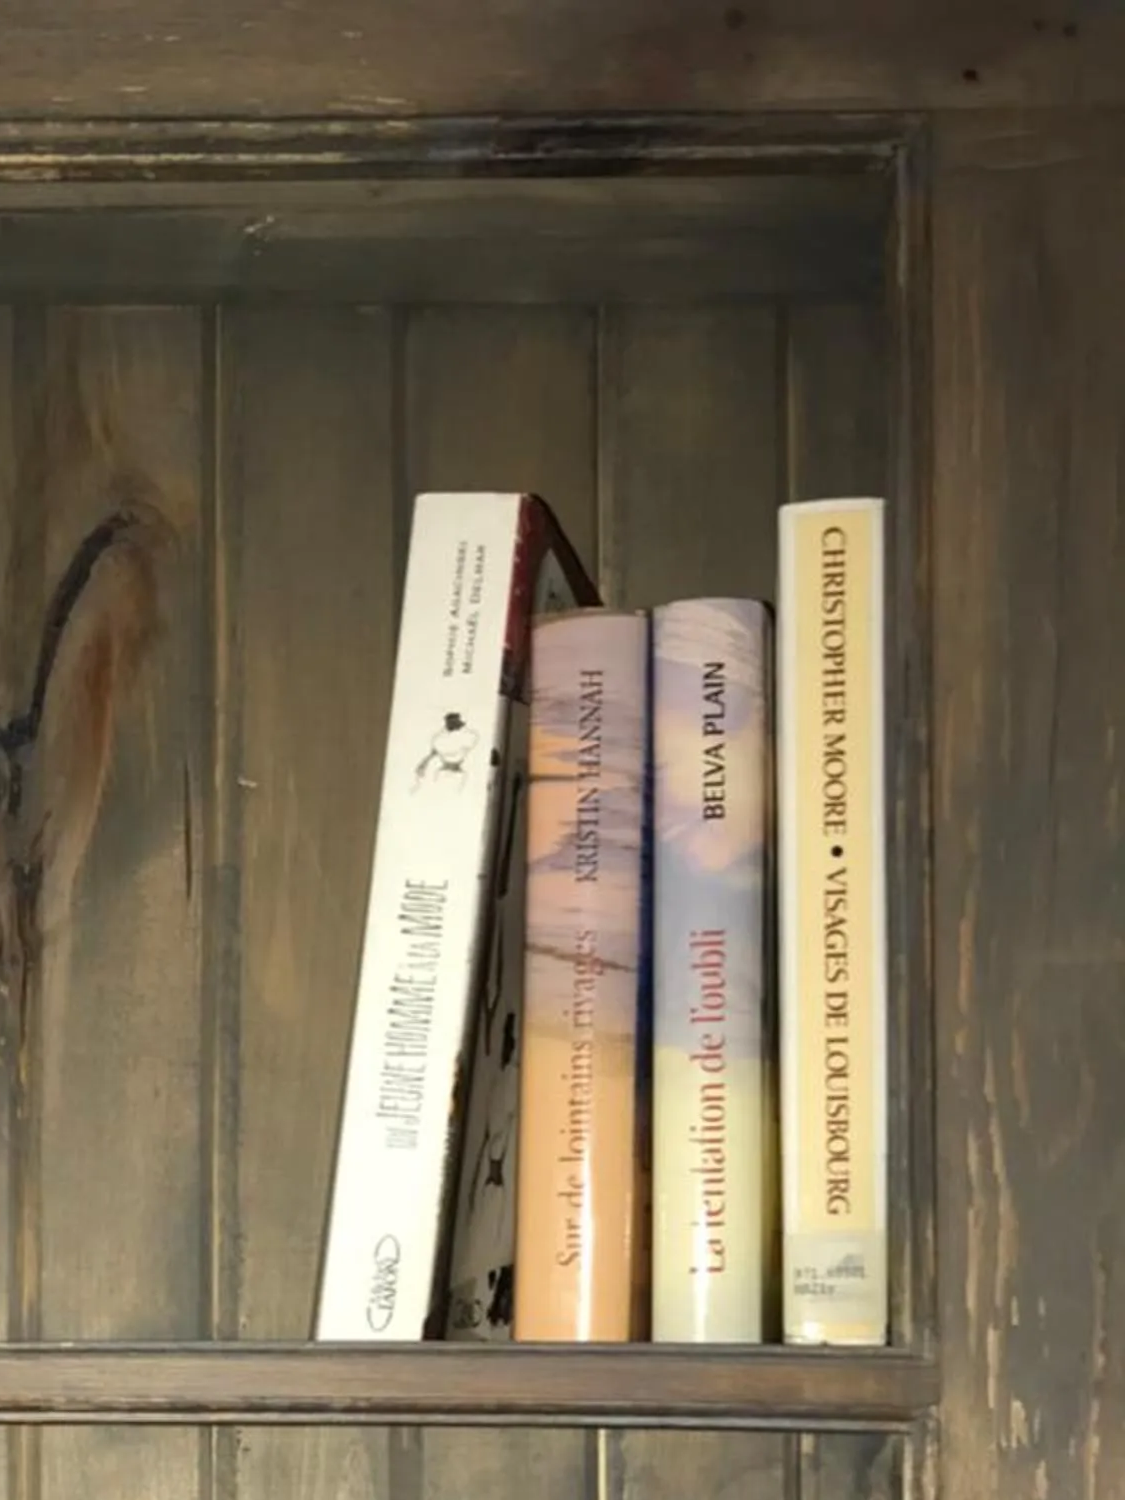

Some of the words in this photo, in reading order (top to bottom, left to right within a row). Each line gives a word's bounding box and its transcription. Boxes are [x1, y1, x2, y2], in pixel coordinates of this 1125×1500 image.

[819, 526, 848, 726] CHRISTOPHER
[576, 669, 603, 778] HANNAH
[702, 661, 725, 736] PLAIN
[702, 743, 725, 820] BELVA
[822, 732, 847, 835] MOORE
[574, 786, 599, 883] KRISTIN
[395, 873, 450, 939] MODE
[822, 865, 850, 982] VISAGES
[380, 969, 438, 1061] HOMME
[567, 930, 605, 1030] rivages
[690, 929, 725, 1023] l'oubli
[824, 991, 848, 1026] DE
[373, 1057, 427, 1126] JEUNE
[689, 1034, 725, 1073] de
[558, 1040, 593, 1163] lointains
[824, 1036, 851, 1215] LOUISBOURG
[557, 1174, 585, 1207] de
[555, 1218, 583, 1267] Sur
